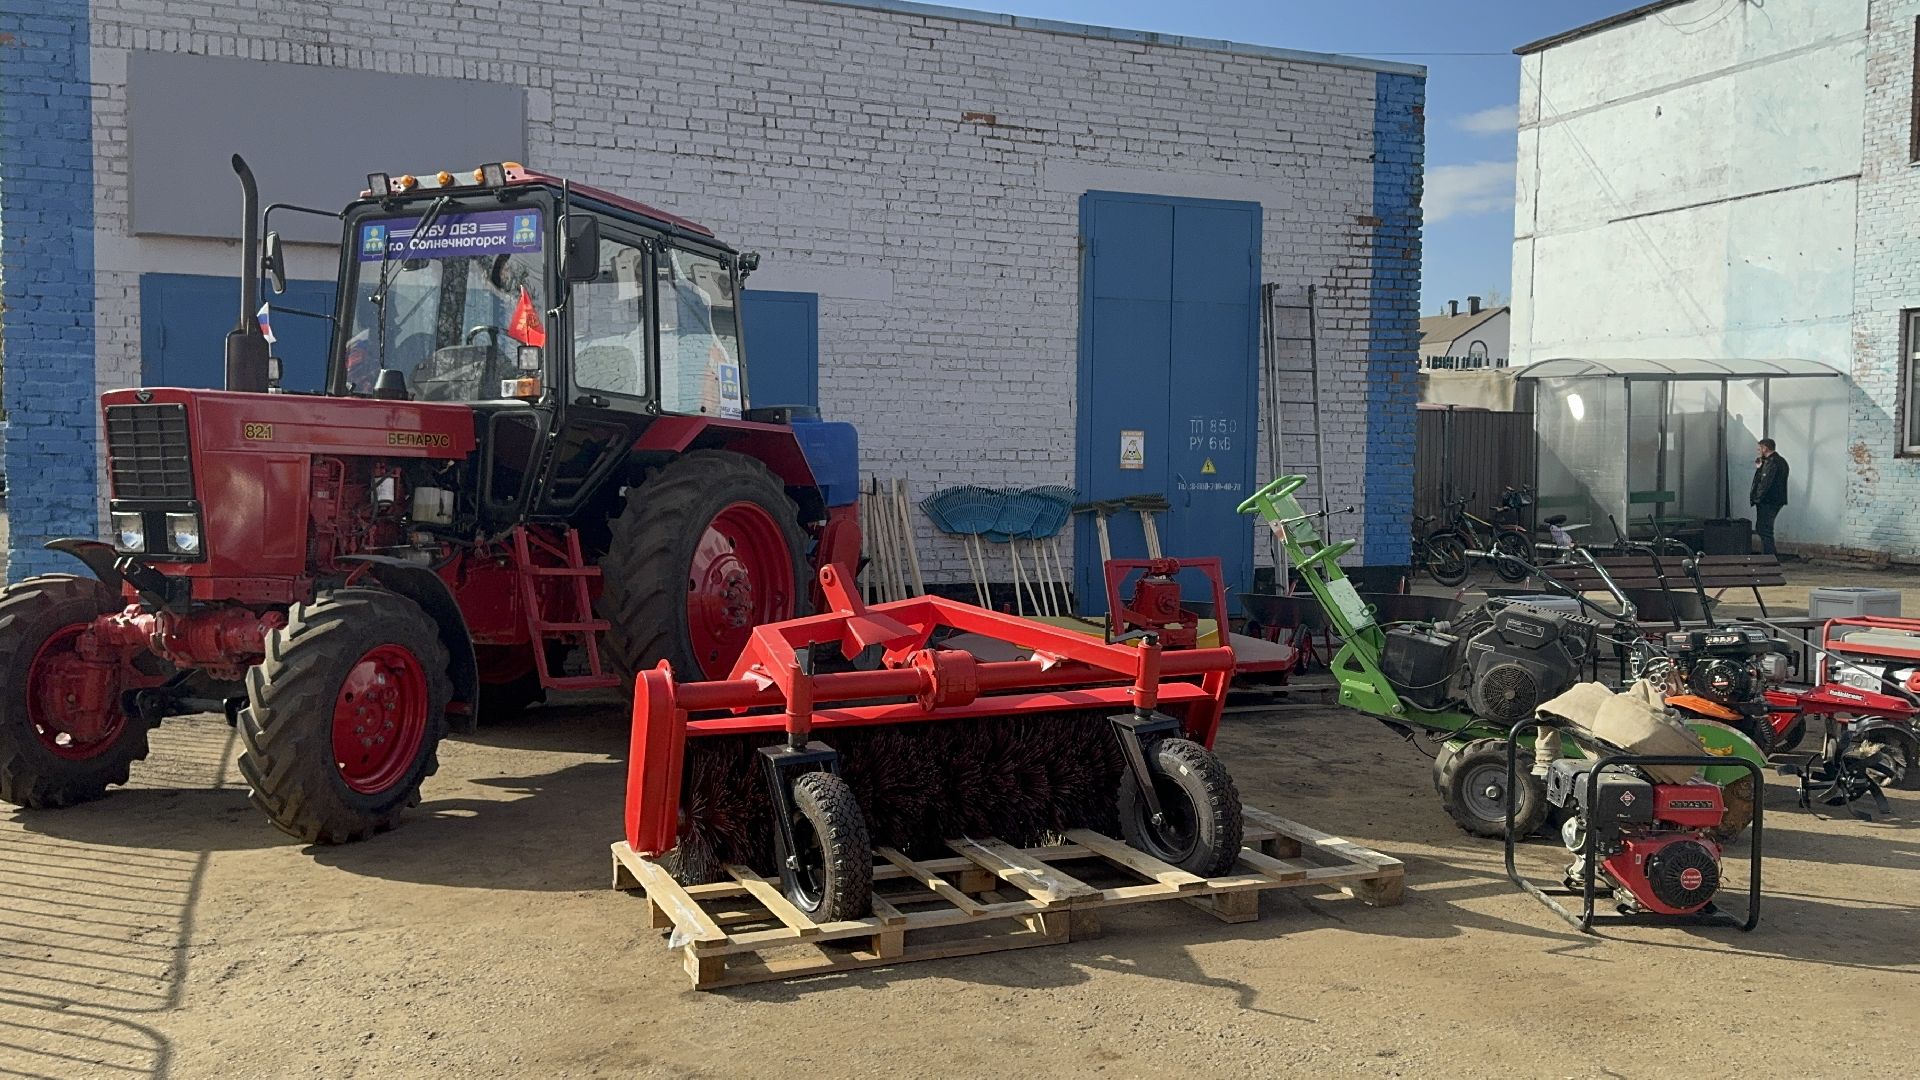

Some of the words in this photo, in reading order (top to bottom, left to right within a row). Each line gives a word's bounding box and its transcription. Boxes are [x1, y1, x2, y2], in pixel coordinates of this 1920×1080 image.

[417, 224, 447, 238] МБУ
[449, 222, 477, 236] ДЕЗ
[410, 235, 507, 250] Солнечногорск
[245, 424, 273, 440] 82.1
[1189, 419, 1204, 434] ТП
[1210, 419, 1237, 433] 850
[388, 432, 450, 447] БЕЛАРУС
[1189, 436, 1204, 450] РУ
[1209, 436, 1231, 450] 6кВ
